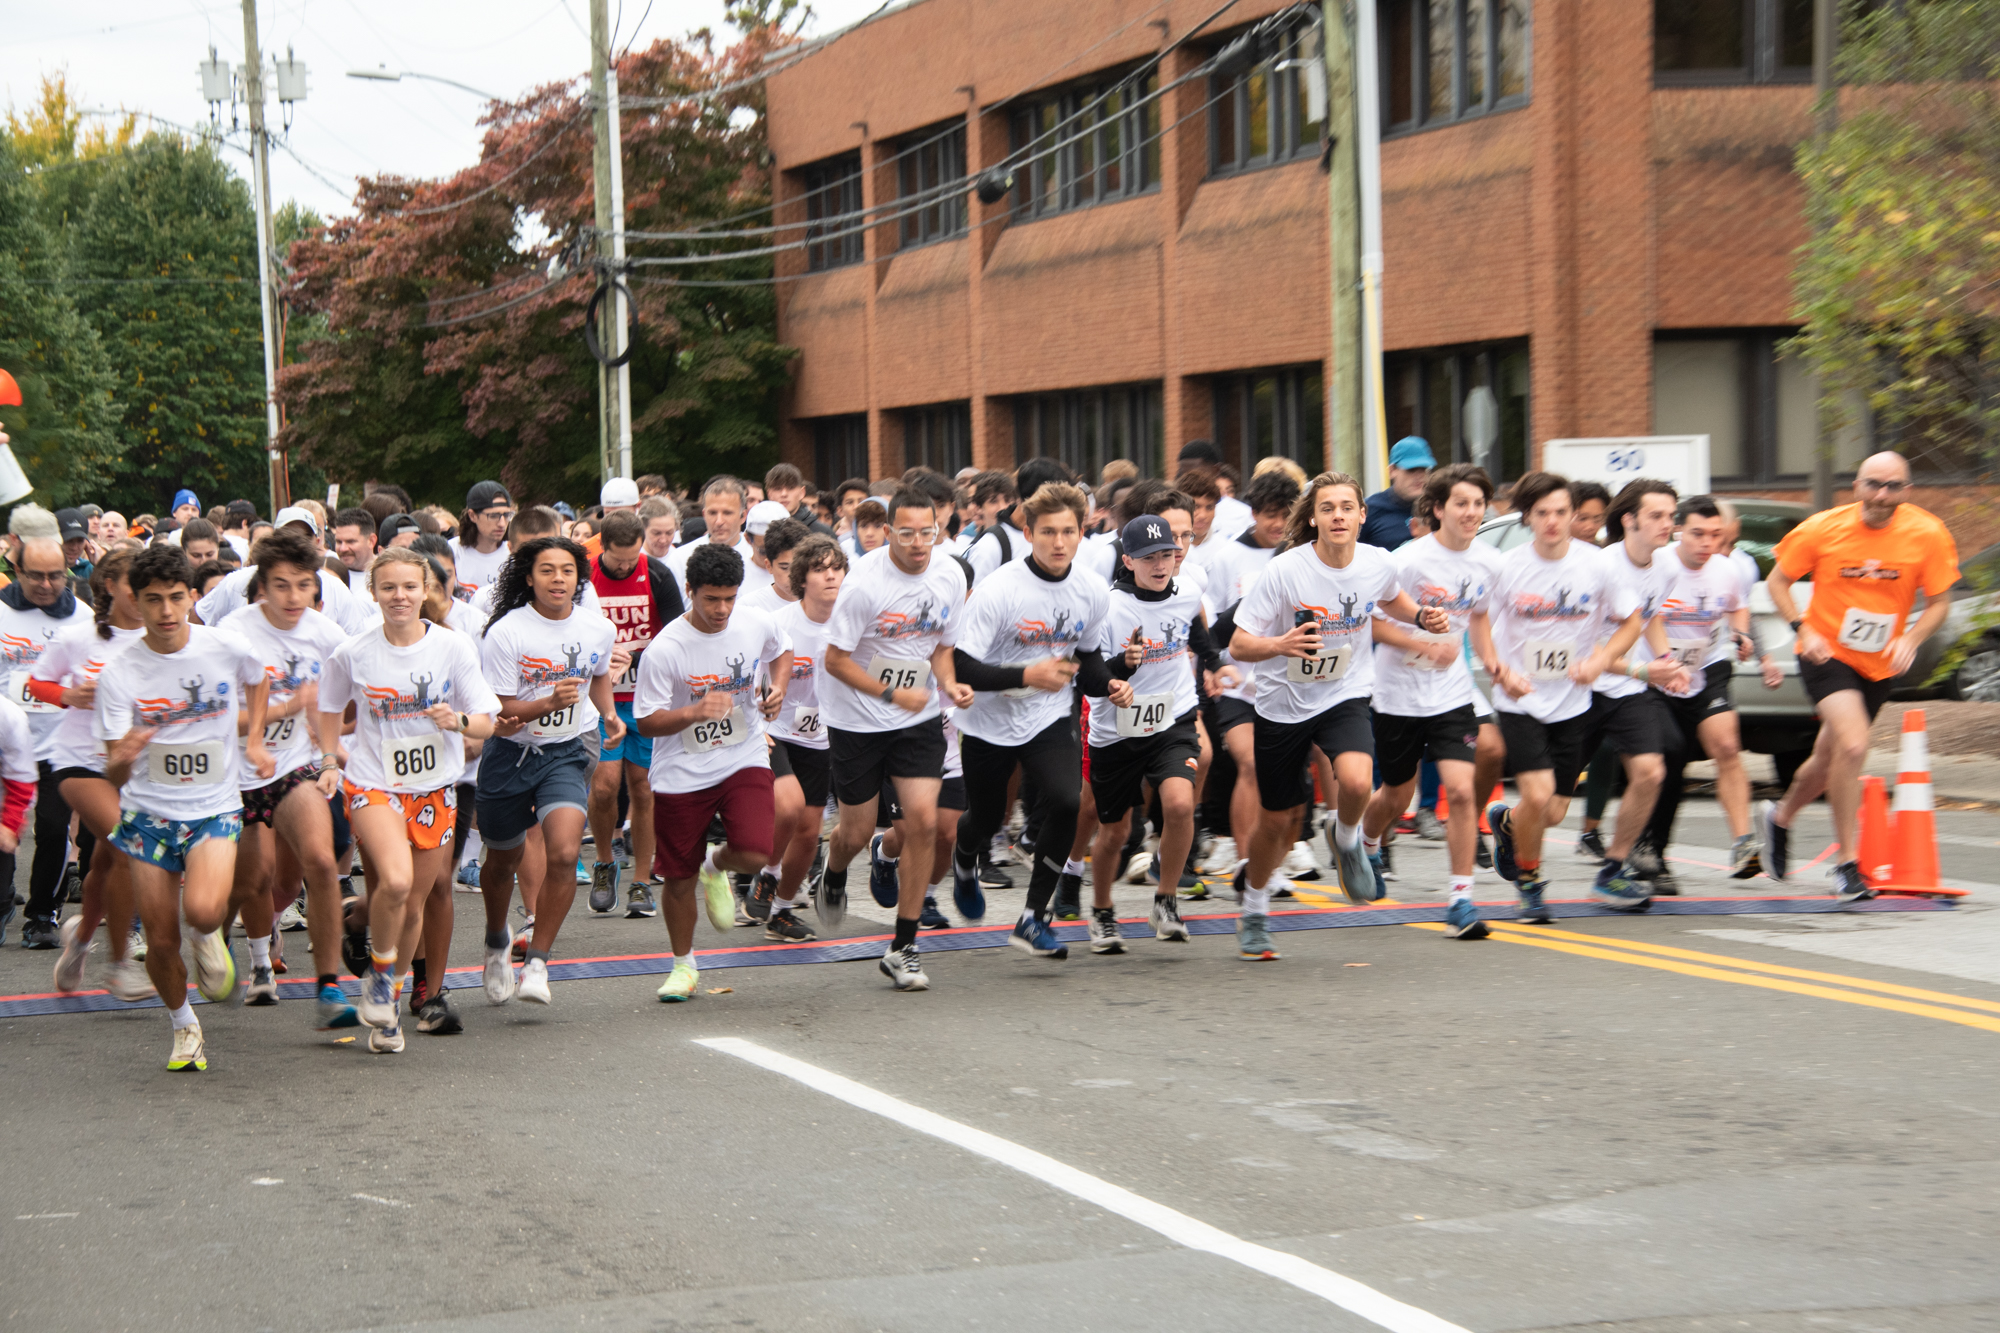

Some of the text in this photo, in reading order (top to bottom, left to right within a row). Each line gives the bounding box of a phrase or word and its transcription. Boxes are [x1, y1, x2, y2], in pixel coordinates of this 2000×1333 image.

[1146, 523, 1162, 539] NY
[1847, 618, 1889, 644] 271
[1301, 655, 1339, 675] 677
[1534, 648, 1570, 672] 143
[878, 668, 917, 690] 615
[798, 713, 821, 732] 26
[1130, 703, 1165, 727] 740
[694, 718, 733, 743] 629
[164, 753, 209, 776] 609
[393, 744, 436, 776] 860
